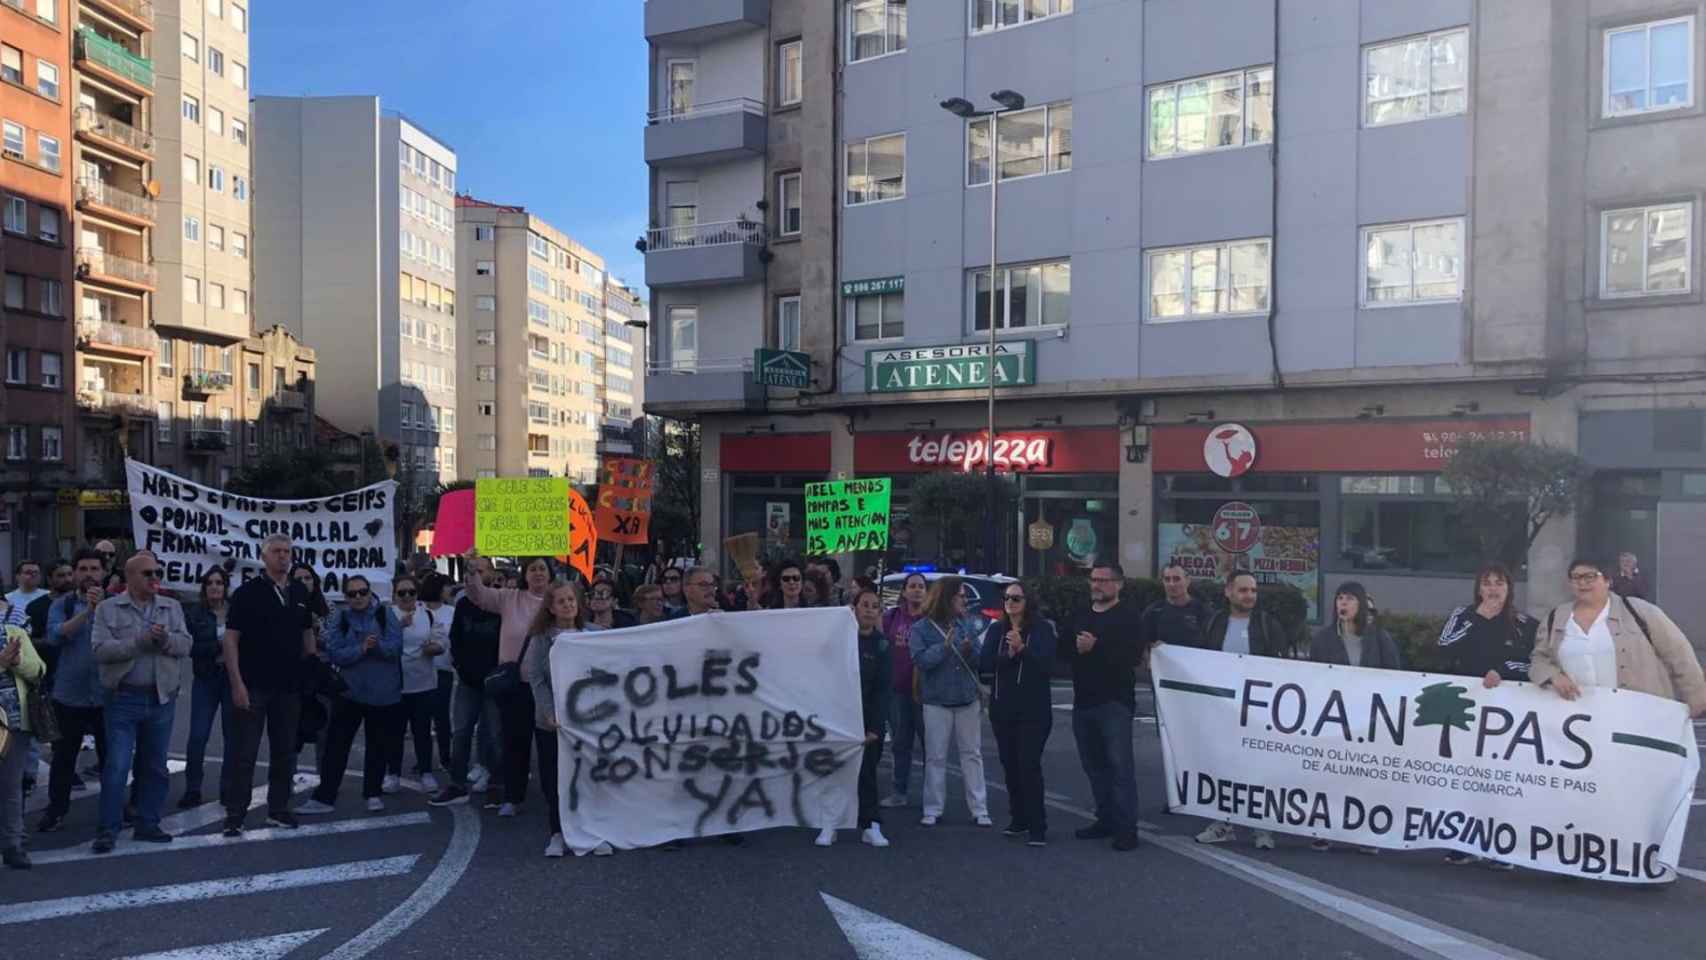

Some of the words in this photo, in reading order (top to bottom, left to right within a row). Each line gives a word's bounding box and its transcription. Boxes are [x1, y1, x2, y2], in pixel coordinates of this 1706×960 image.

[884, 345, 1008, 362] ASESORIA
[886, 361, 1009, 389] ATENEA
[909, 432, 1049, 472] telepizza
[807, 484, 836, 497] ABEL
[844, 480, 885, 495] MENOS
[857, 498, 865, 511] E
[162, 506, 229, 535] POMBAL
[612, 514, 641, 535] XA
[809, 535, 827, 550] AS
[837, 530, 886, 550] ANPAS
[322, 547, 387, 569] CABRAL
[566, 649, 761, 724] COLES
[599, 710, 827, 753] OLVIDADOS
[1241, 737, 1324, 758] FEDERACION
[1327, 748, 1379, 766] OLÍVICA
[1382, 756, 1401, 768] DE
[1404, 759, 1492, 780] ASOCIACIÓNS
[1494, 770, 1513, 782] DE
[1515, 772, 1547, 787] NAIS
[1550, 777, 1560, 789] E
[1563, 778, 1597, 794] PAIS
[1302, 759, 1321, 772] DE
[1323, 762, 1388, 781] ALUMNOS
[1391, 771, 1410, 784] DE
[1414, 773, 1448, 788] VIGO
[1451, 778, 1460, 790] E
[1462, 780, 1524, 798] COMARCA
[1197, 772, 1332, 829] DEFENSA
[1343, 795, 1394, 835] DO
[1404, 807, 1517, 855] ENSINO
[1530, 823, 1667, 879] PÚBLIC
